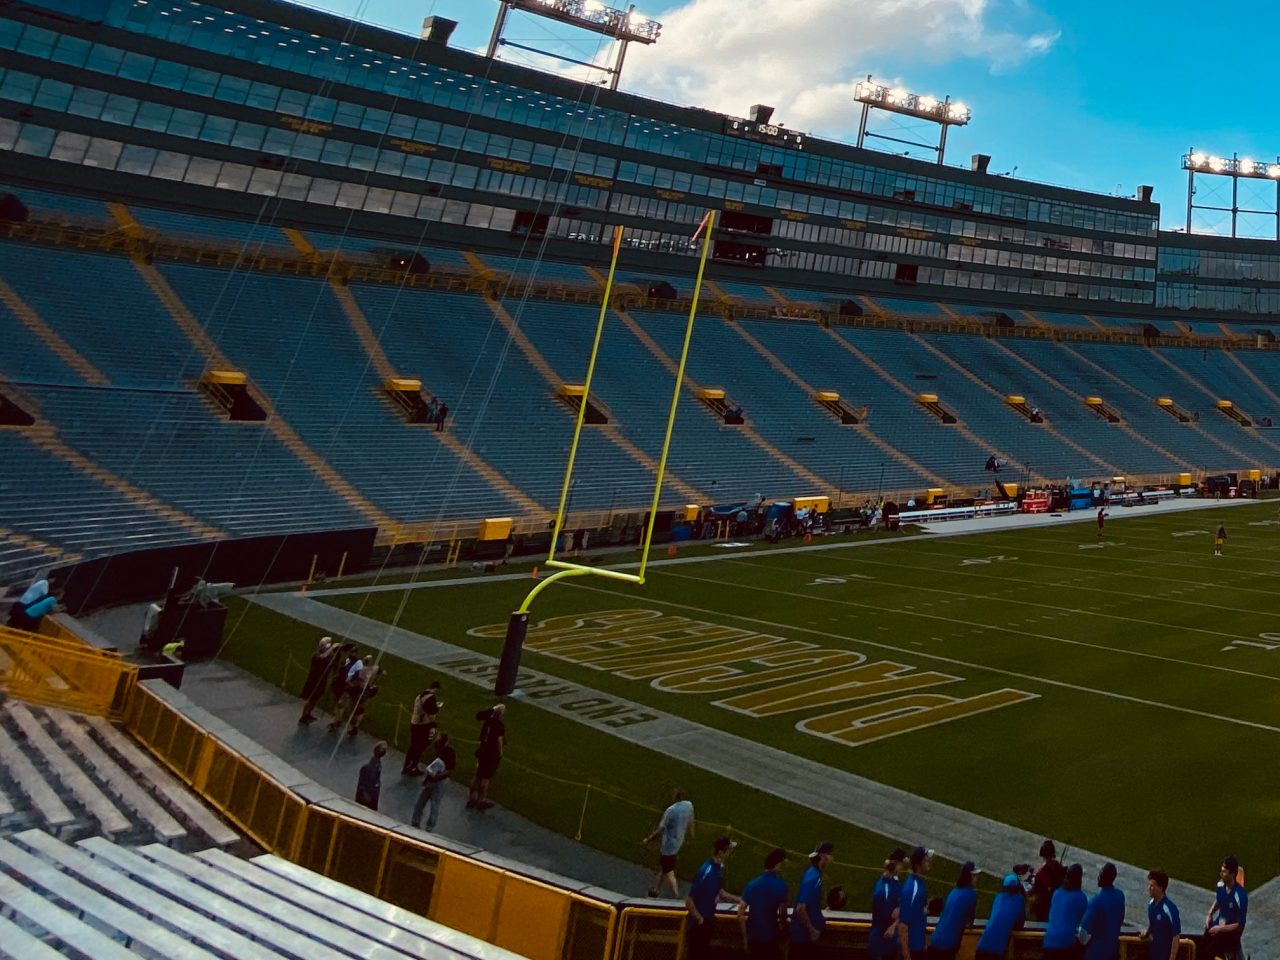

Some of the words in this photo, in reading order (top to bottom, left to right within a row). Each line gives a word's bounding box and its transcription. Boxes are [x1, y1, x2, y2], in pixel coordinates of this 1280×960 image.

[759, 124, 778, 136] 15:00
[466, 608, 1042, 747] PACKERS
[559, 697, 660, 729] END
